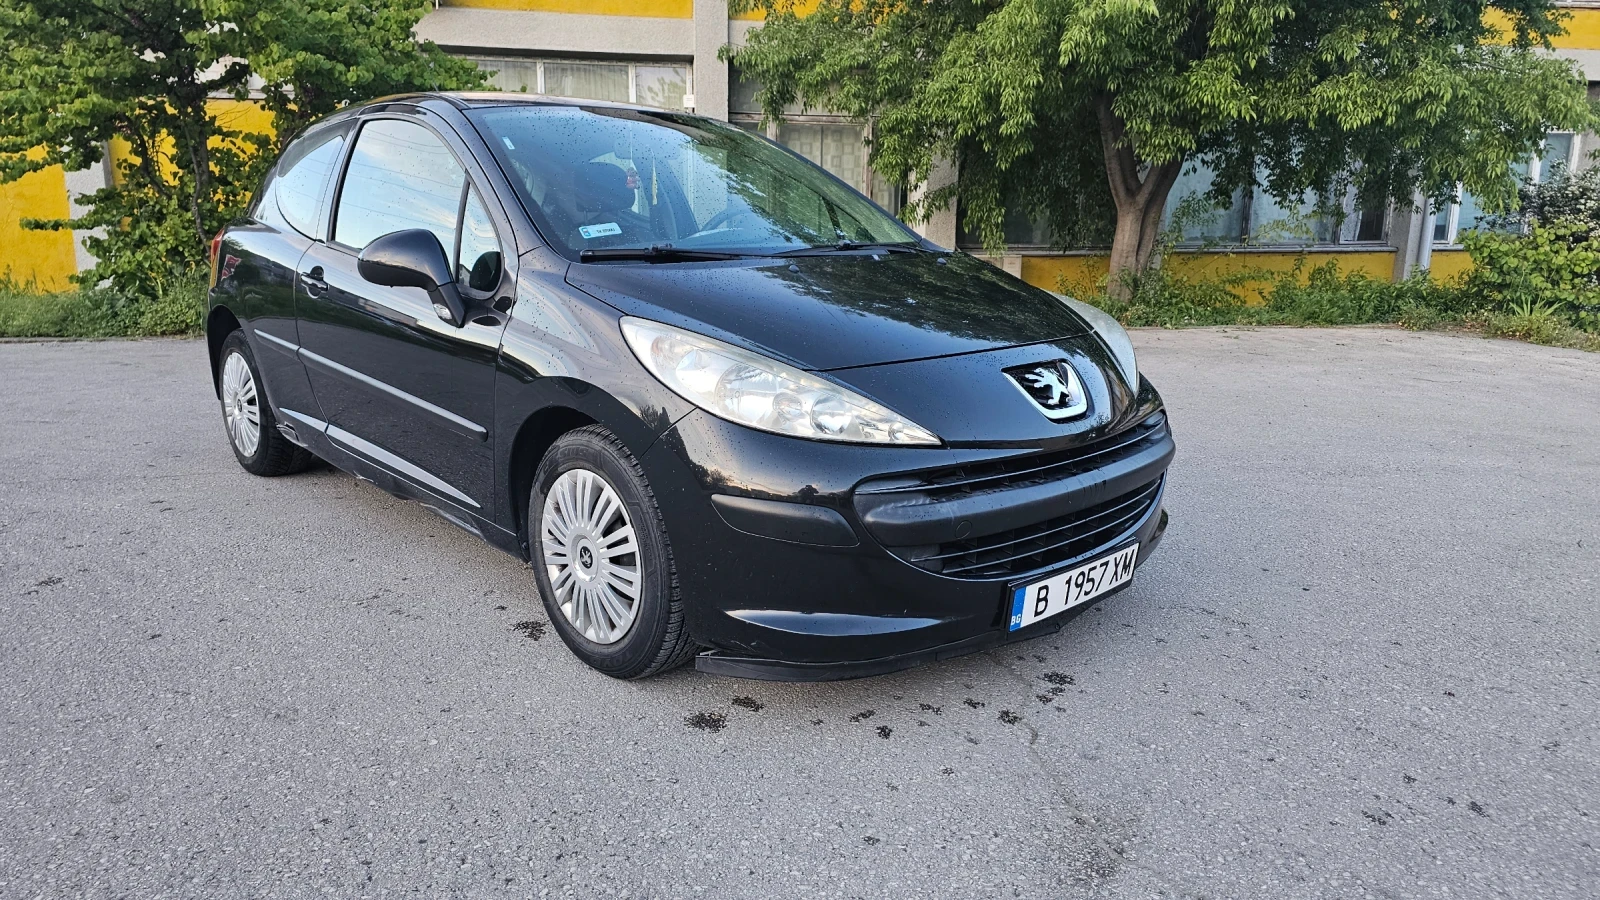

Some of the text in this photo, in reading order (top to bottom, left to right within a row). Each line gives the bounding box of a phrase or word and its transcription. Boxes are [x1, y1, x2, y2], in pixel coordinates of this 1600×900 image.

[1034, 549, 1135, 618] B 1957 XM
[1010, 614, 1022, 626] BG
